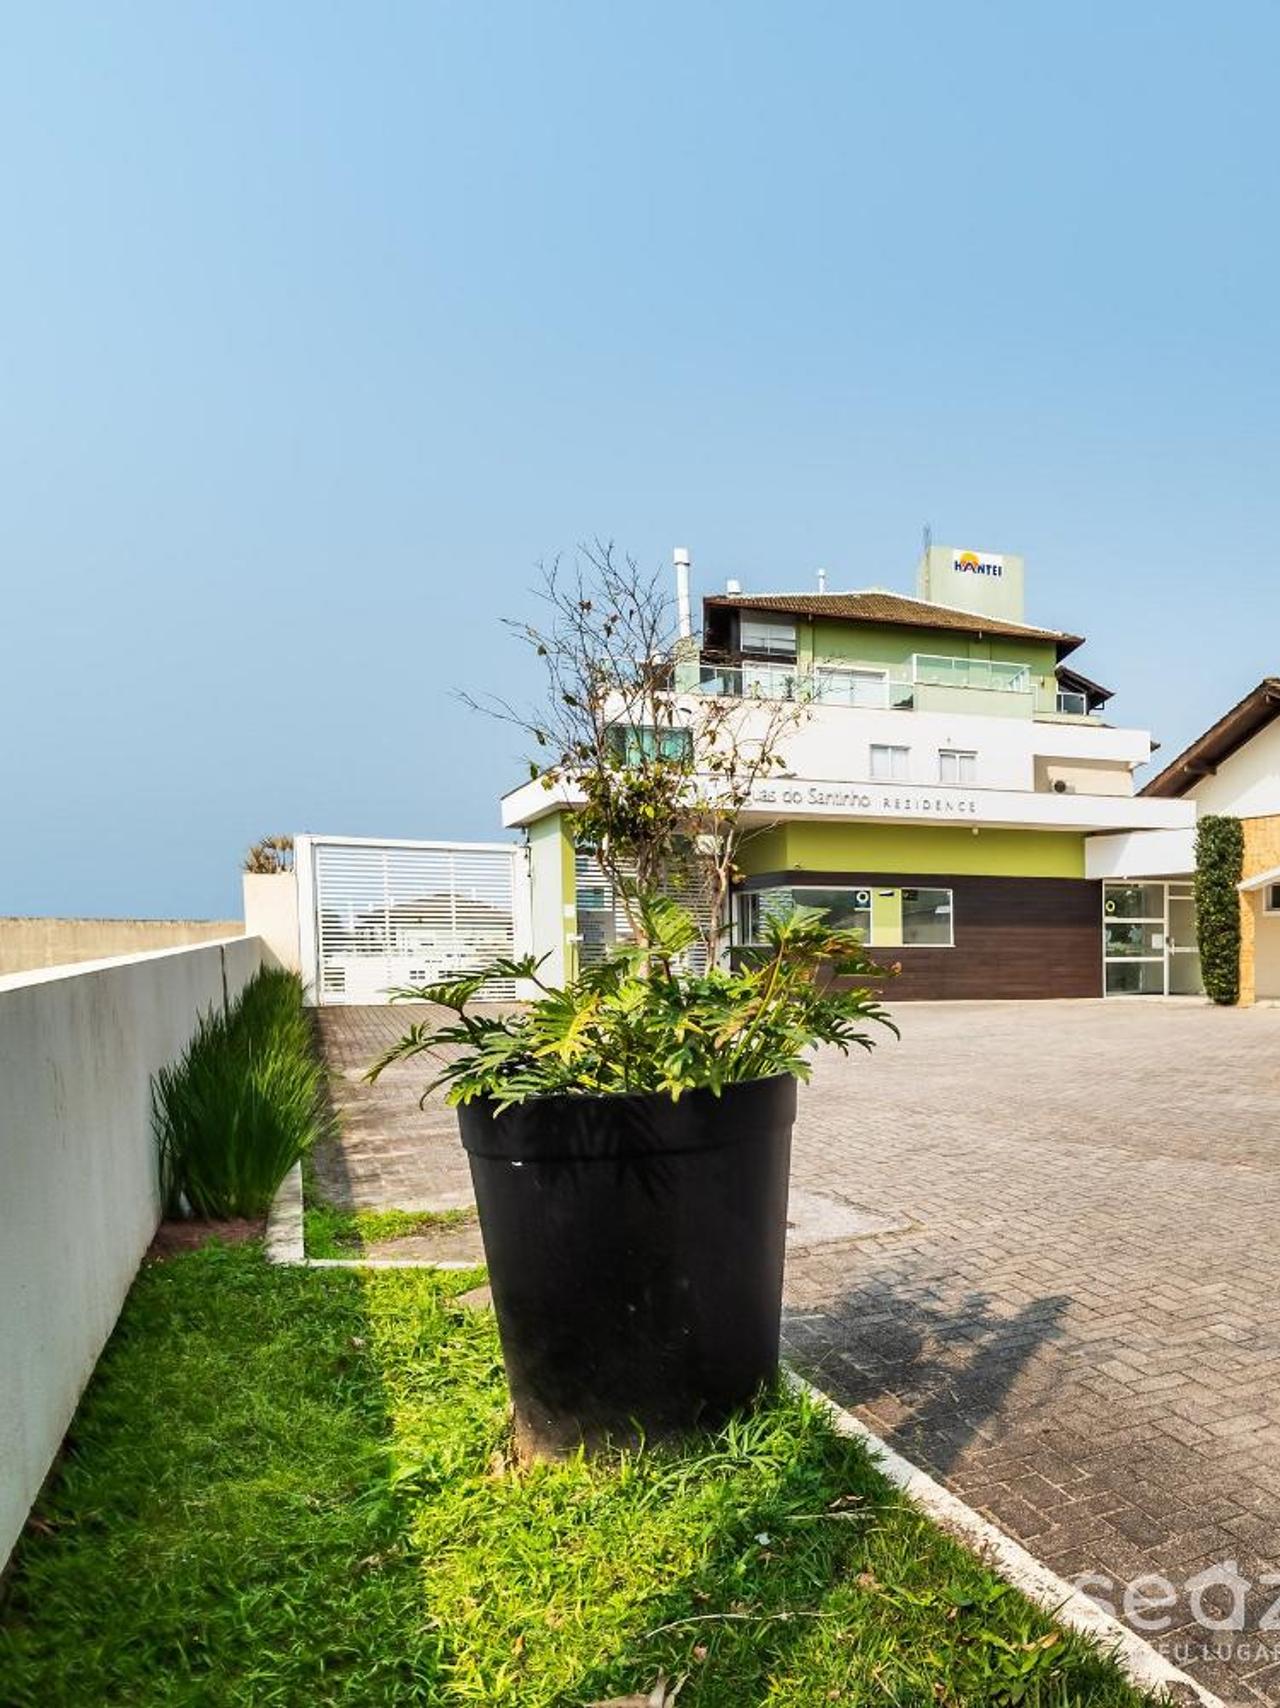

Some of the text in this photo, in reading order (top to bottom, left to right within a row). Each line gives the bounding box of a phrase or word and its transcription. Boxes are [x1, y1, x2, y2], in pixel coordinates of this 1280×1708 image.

[954, 560, 1003, 577] HANTEI
[783, 788, 803, 804] do
[808, 787, 871, 808] Santinho
[883, 797, 976, 813] RESIDENCE
